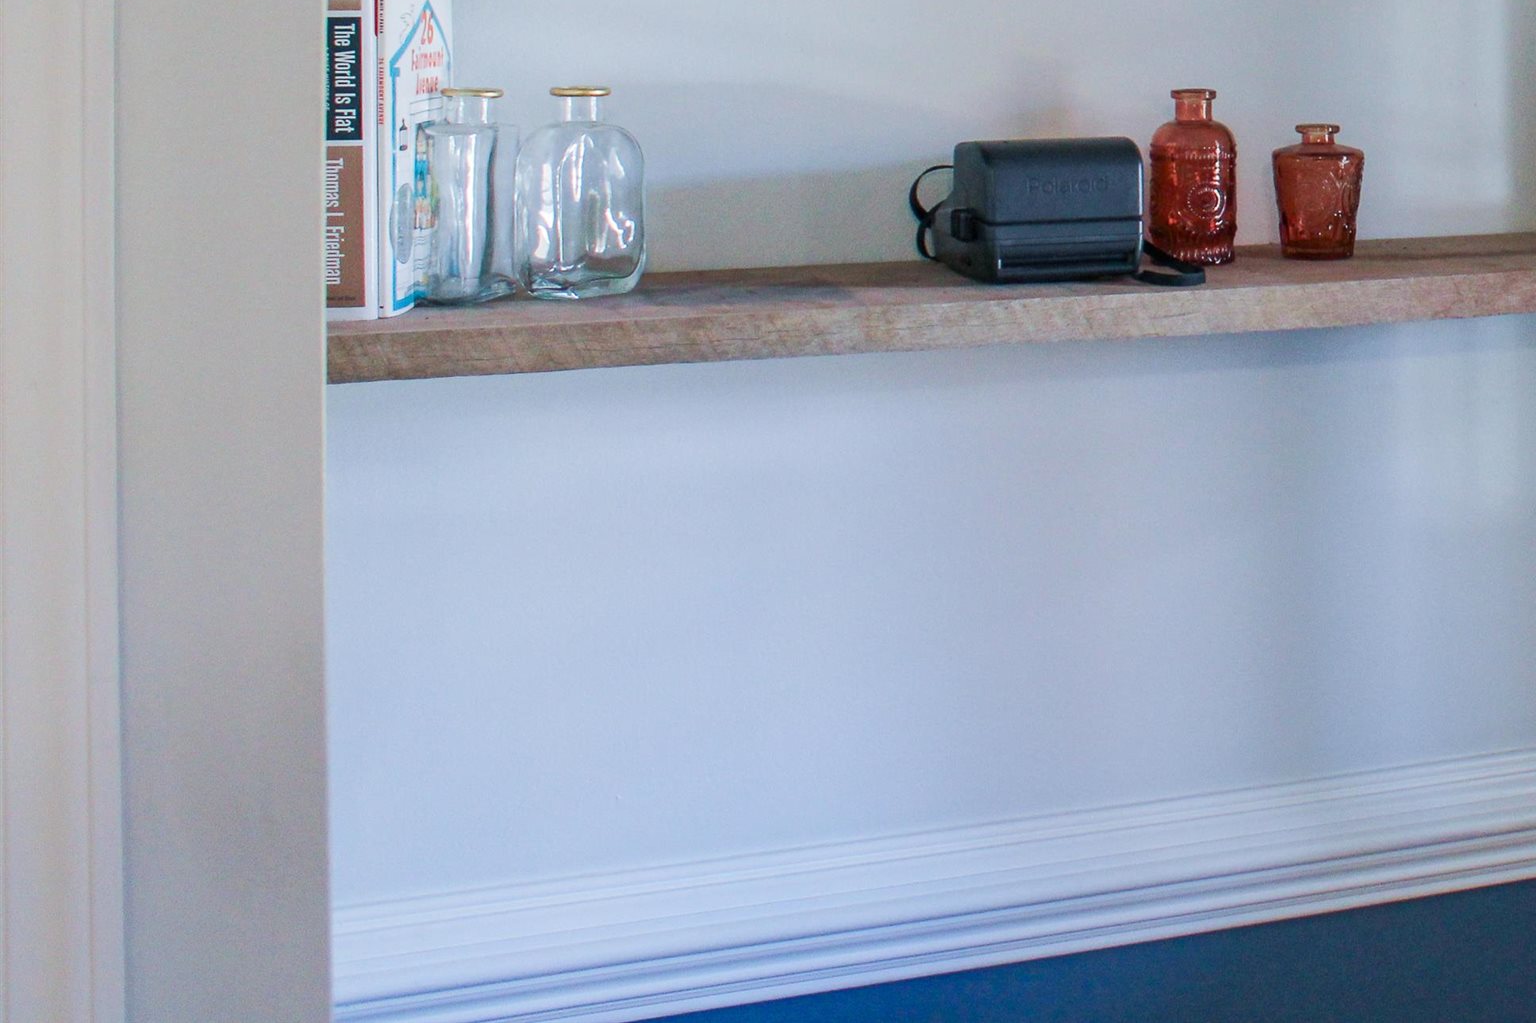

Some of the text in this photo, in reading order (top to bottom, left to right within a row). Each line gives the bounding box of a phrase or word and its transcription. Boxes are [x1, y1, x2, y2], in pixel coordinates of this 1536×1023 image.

[420, 10, 434, 46] 26
[334, 23, 357, 134] The World Is Flat
[411, 47, 444, 72] Fairmount
[326, 157, 344, 208] Thomas
[326, 226, 345, 285] Friedman
